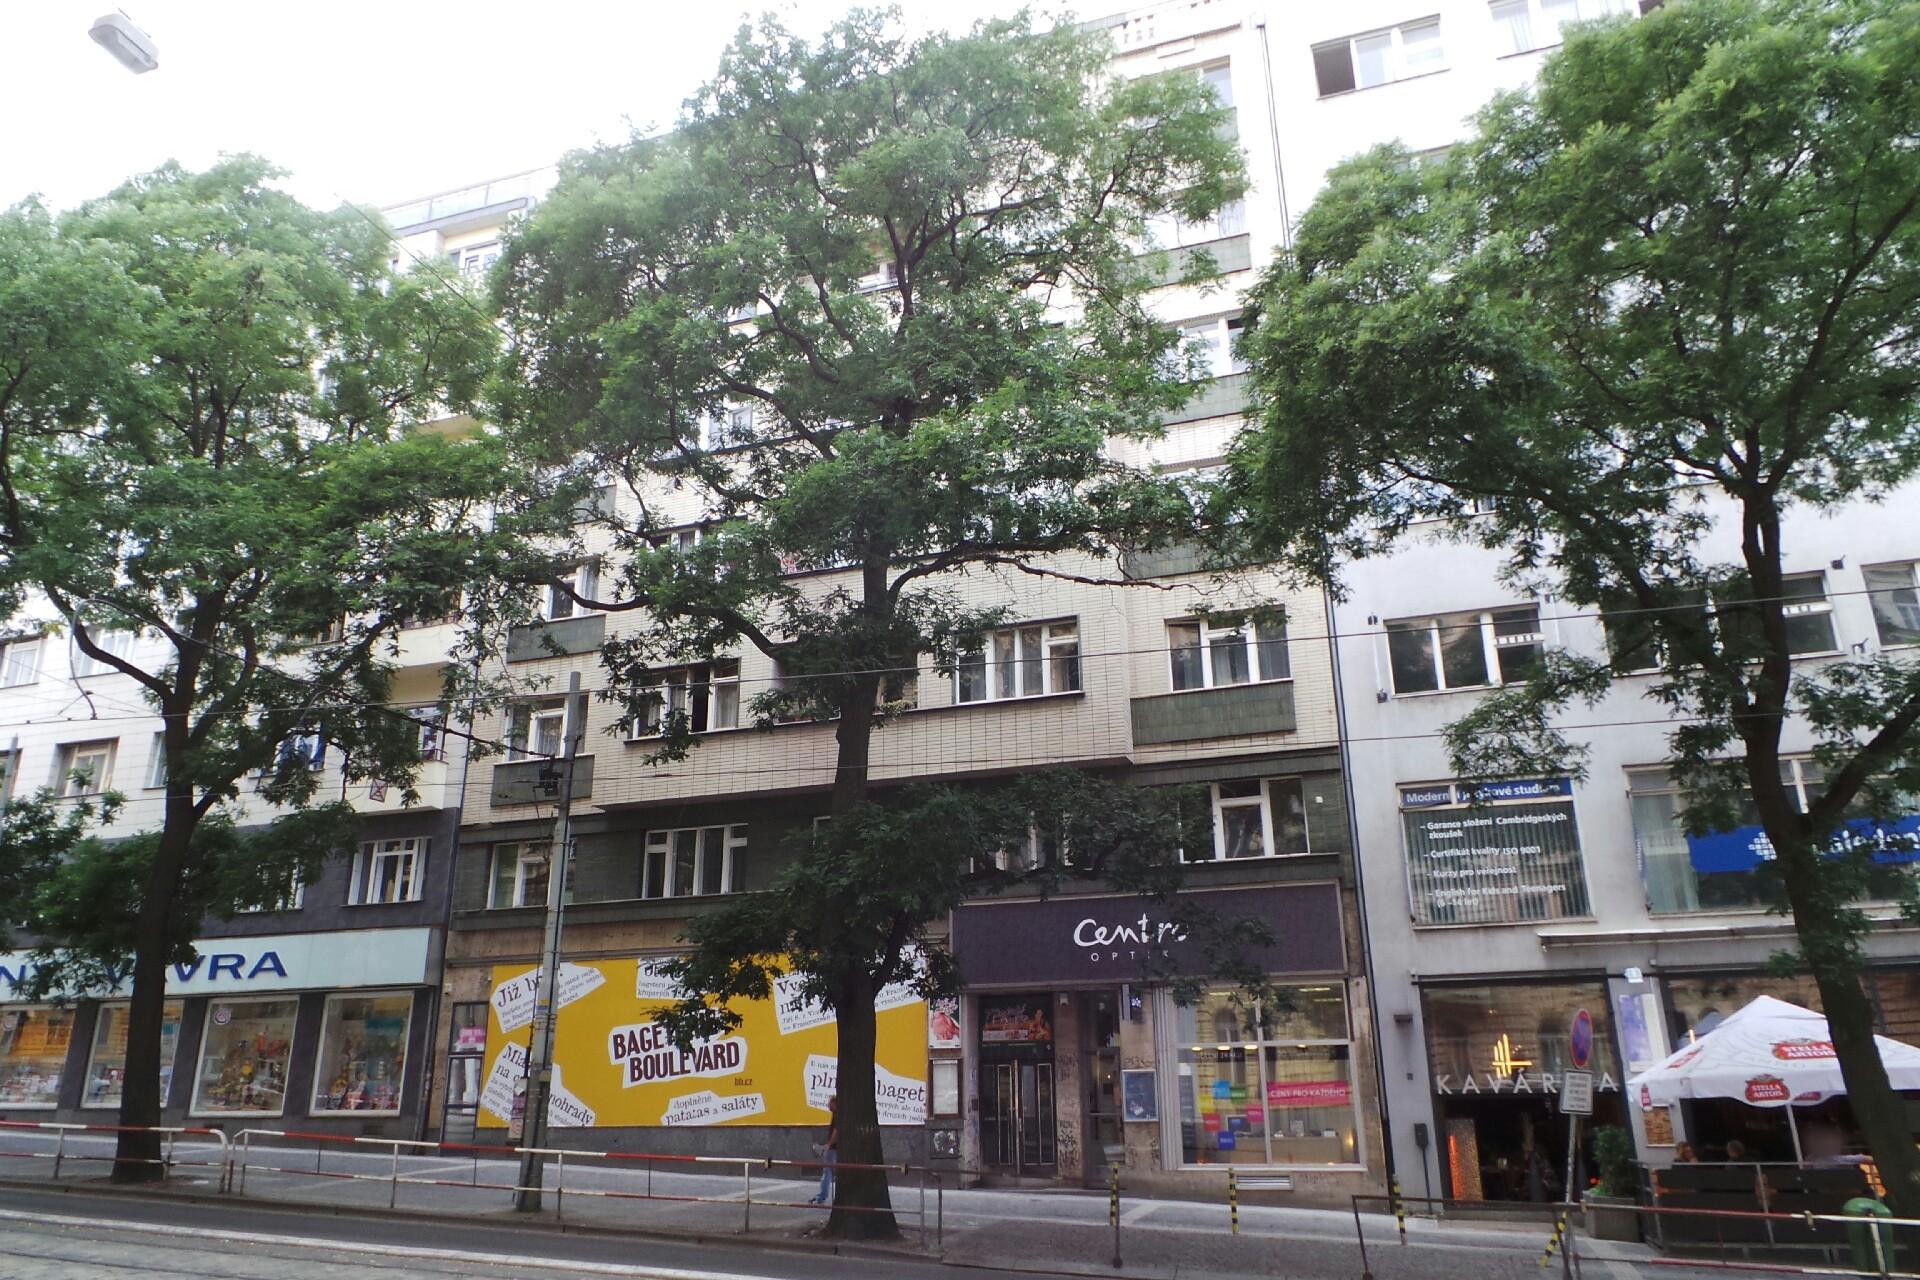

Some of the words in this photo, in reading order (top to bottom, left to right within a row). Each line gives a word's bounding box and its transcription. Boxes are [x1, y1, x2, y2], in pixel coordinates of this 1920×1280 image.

[1427, 820, 1461, 830] Garance
[1496, 813, 1567, 826] Cambridgeských
[1431, 847, 1471, 858] Certifikát
[1471, 846, 1500, 858] kvality
[1503, 848, 1518, 856] ISO
[1520, 846, 1540, 854] 9001
[1433, 869, 1457, 879] Kurzy
[1460, 869, 1475, 878] pro
[1435, 888, 1465, 898] English
[1467, 887, 1480, 895] for
[498, 983, 522, 1008] Již
[1782, 1044, 1830, 1052] STELLA
[1788, 1050, 1837, 1058] ARTOIS
[630, 1042, 740, 1082] BOULEVARD
[1436, 1067, 1619, 1095] KAVÁRA
[1271, 1089, 1290, 1098] CENY
[1751, 1084, 1781, 1092] STELLA
[1753, 1090, 1784, 1098] ARTOIS
[721, 1096, 758, 1113] saláty
